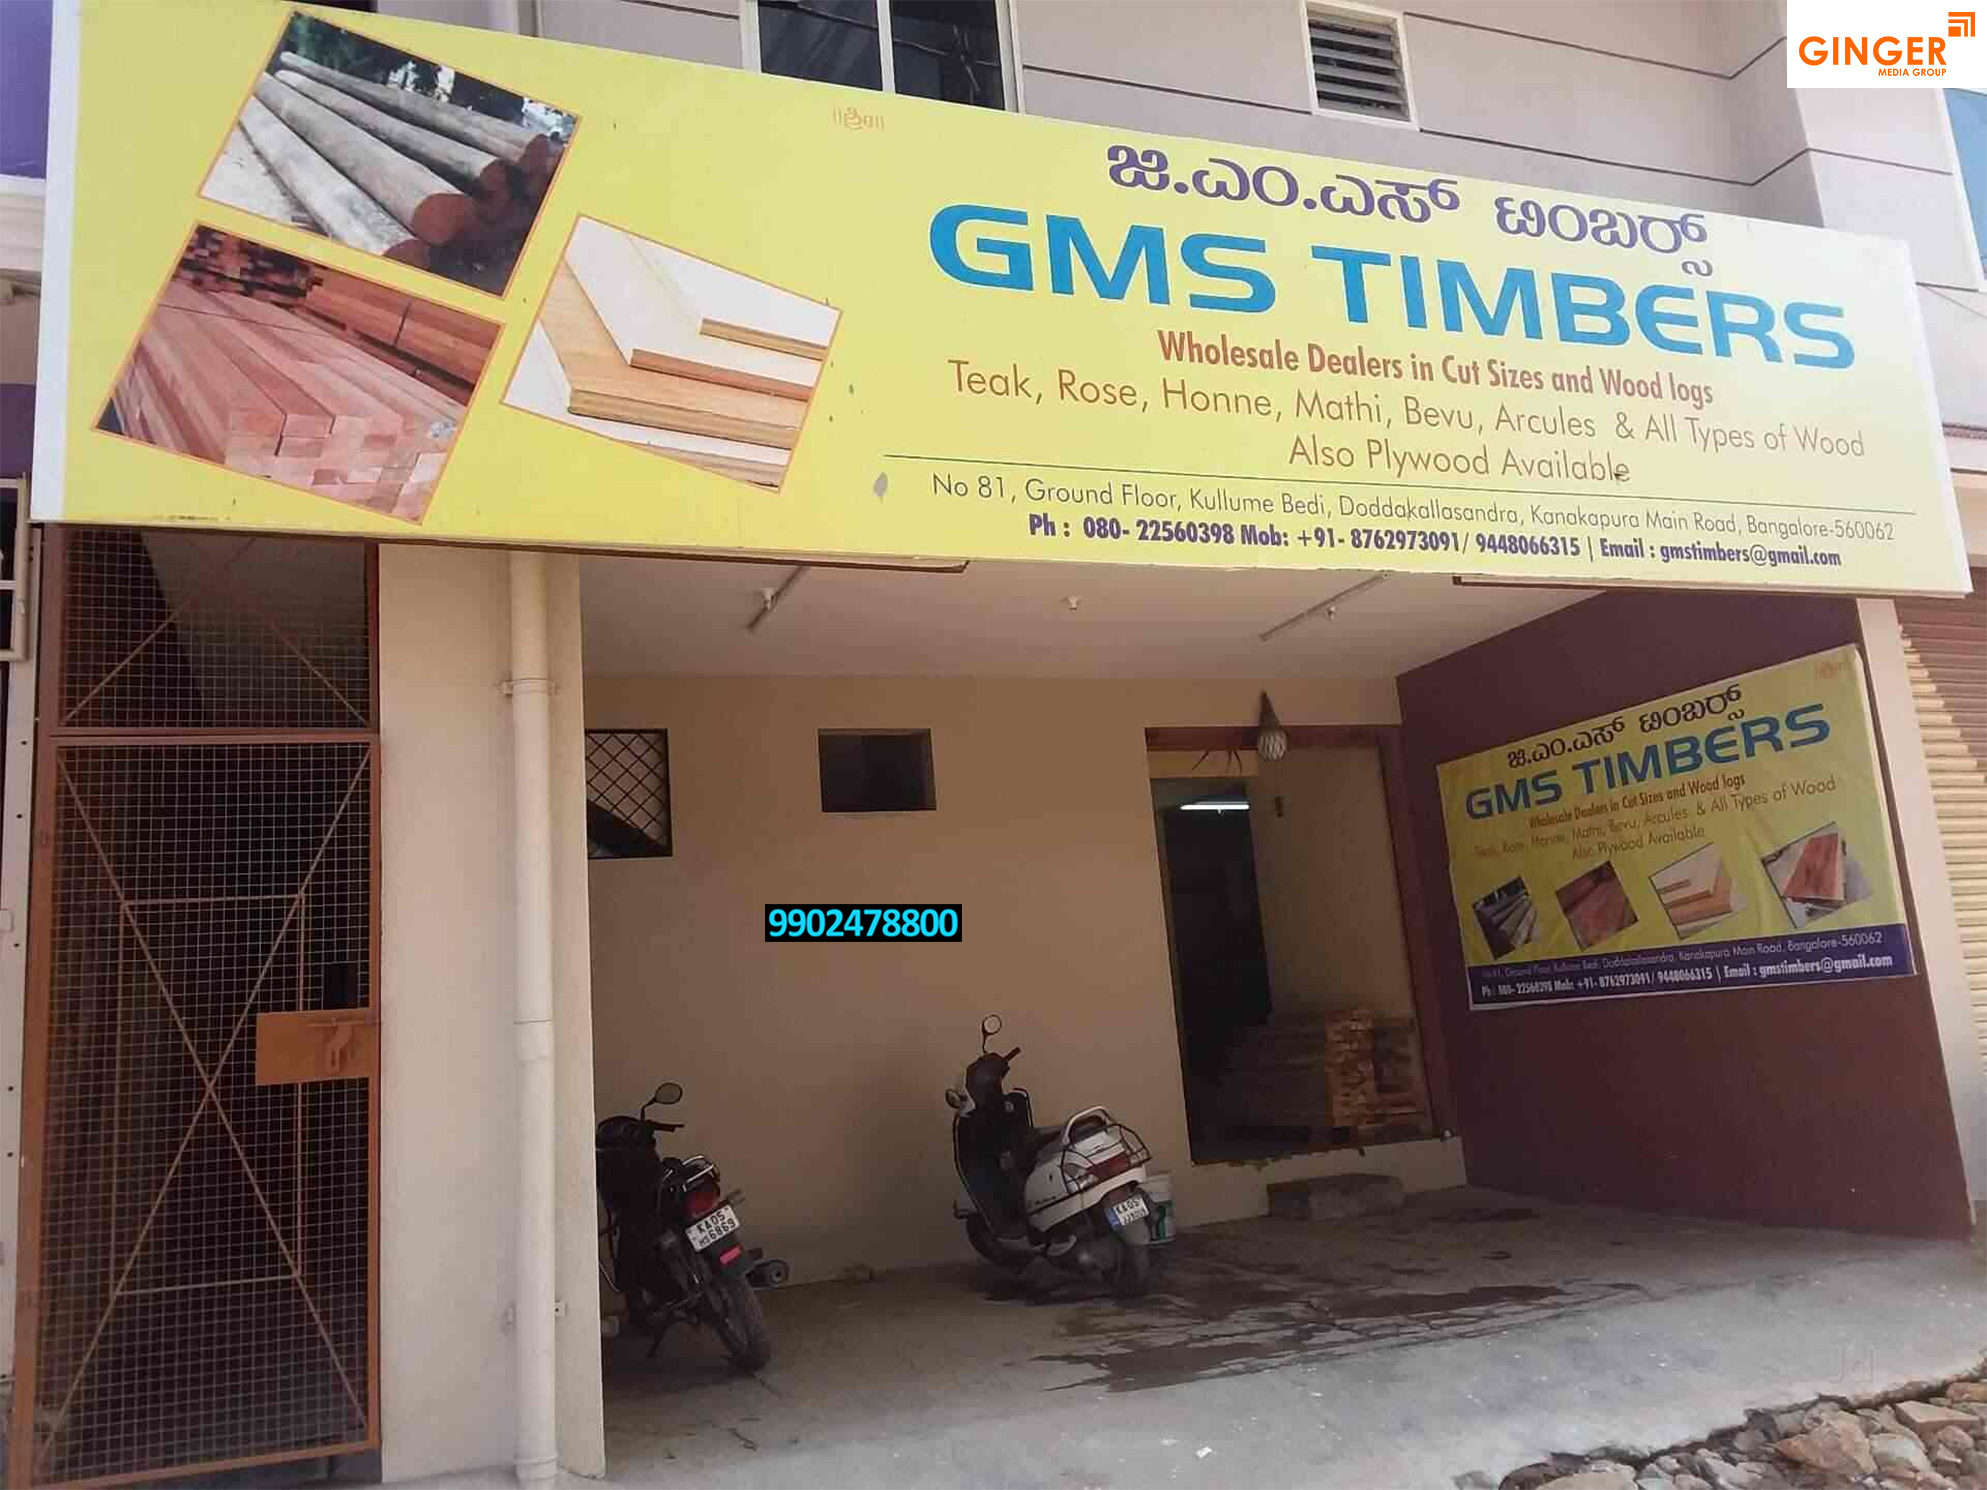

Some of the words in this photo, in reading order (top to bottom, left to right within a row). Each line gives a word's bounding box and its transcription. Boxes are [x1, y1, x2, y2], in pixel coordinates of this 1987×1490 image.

[930, 204, 1275, 313] GMS
[1311, 245, 1855, 369] TIMBERS
[1157, 330, 1300, 371] Wholesale
[1308, 343, 1403, 379] Dealers
[1411, 353, 1433, 381] in
[1442, 355, 1480, 385] Cut
[1487, 359, 1544, 390] Sizes
[1552, 366, 1593, 393] and
[1599, 367, 1663, 399] Wood
[1669, 372, 1714, 410] logs
[947, 359, 1042, 405] Teak,
[1058, 368, 1148, 413] Rose,
[1162, 377, 1282, 422] Honne,
[1295, 389, 1391, 429] Mathi,
[1404, 395, 1483, 435] Bevu,
[1495, 402, 1596, 437] Arcules
[1615, 410, 1634, 440] &
[1645, 413, 1677, 443] All
[1685, 416, 1755, 453] Types
[1764, 423, 1788, 450] of
[1794, 425, 1864, 457] Wood
[1289, 434, 1354, 467] Also
[1367, 438, 1489, 478] Plywood
[1501, 448, 1630, 482] Available
[932, 473, 968, 498] No
[1025, 478, 1112, 505] Ground
[1122, 483, 1181, 512] Floor,
[1190, 488, 1273, 513] Kullume
[1282, 492, 1332, 519] Bedi,
[1340, 495, 1524, 526] Doddakallasandra,
[1530, 504, 1639, 530] Kanakapura
[1646, 510, 1688, 531] Main
[1694, 512, 1742, 536] Road,
[1748, 515, 1895, 541] Bangalore-560062
[1083, 516, 1129, 540] 080-
[1136, 518, 1235, 545] 22560398
[1241, 524, 1288, 547] Mob:
[1297, 527, 1345, 548] +91-
[1475, 532, 1581, 557] 9448066315
[1660, 541, 1842, 567] gmstimbers@gmail.com
[1466, 770, 1563, 819] GMS
[1571, 703, 1831, 794] TIMBERS
[1610, 800, 1620, 812] in
[1667, 784, 1686, 799] and
[1688, 778, 1720, 795] Wood
[1723, 773, 1746, 791] logs
[1711, 798, 1729, 813] All
[1731, 792, 1768, 811] Types
[1773, 785, 1788, 800] of
[1791, 774, 1837, 796] Wood
[1759, 953, 1893, 978] gmstimbers@gmail.com
[1788, 931, 1882, 951] Bangalore-560062
